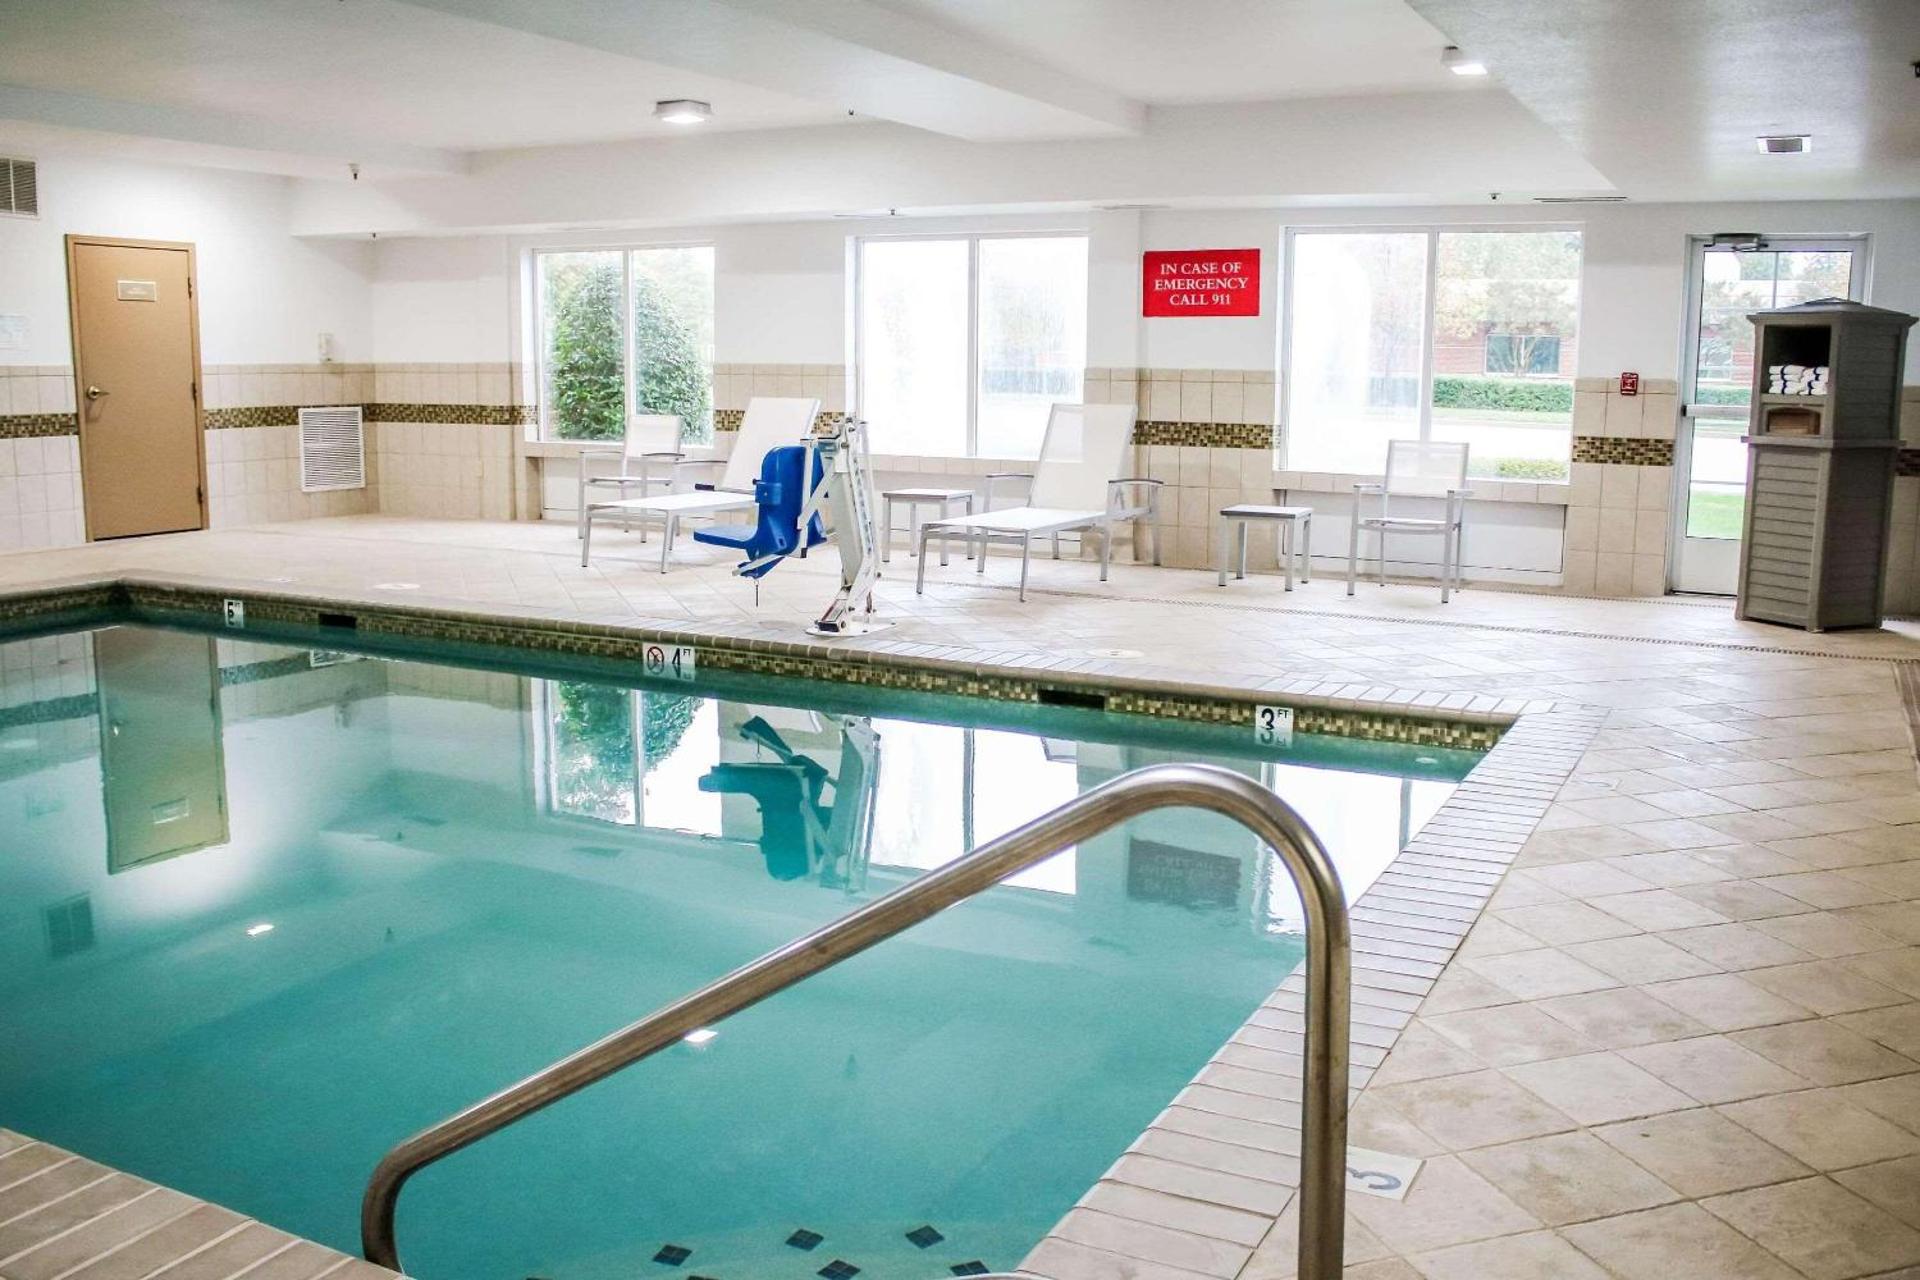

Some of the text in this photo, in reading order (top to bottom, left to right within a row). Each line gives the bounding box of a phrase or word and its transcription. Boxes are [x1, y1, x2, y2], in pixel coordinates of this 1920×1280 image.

[1161, 261, 1242, 275] IN CASE OF
[1154, 277, 1249, 291] EMERGENCY
[1169, 294, 1231, 306] CALL 911
[671, 647, 691, 666] 4 FT
[1261, 708, 1289, 731] 3 FT
